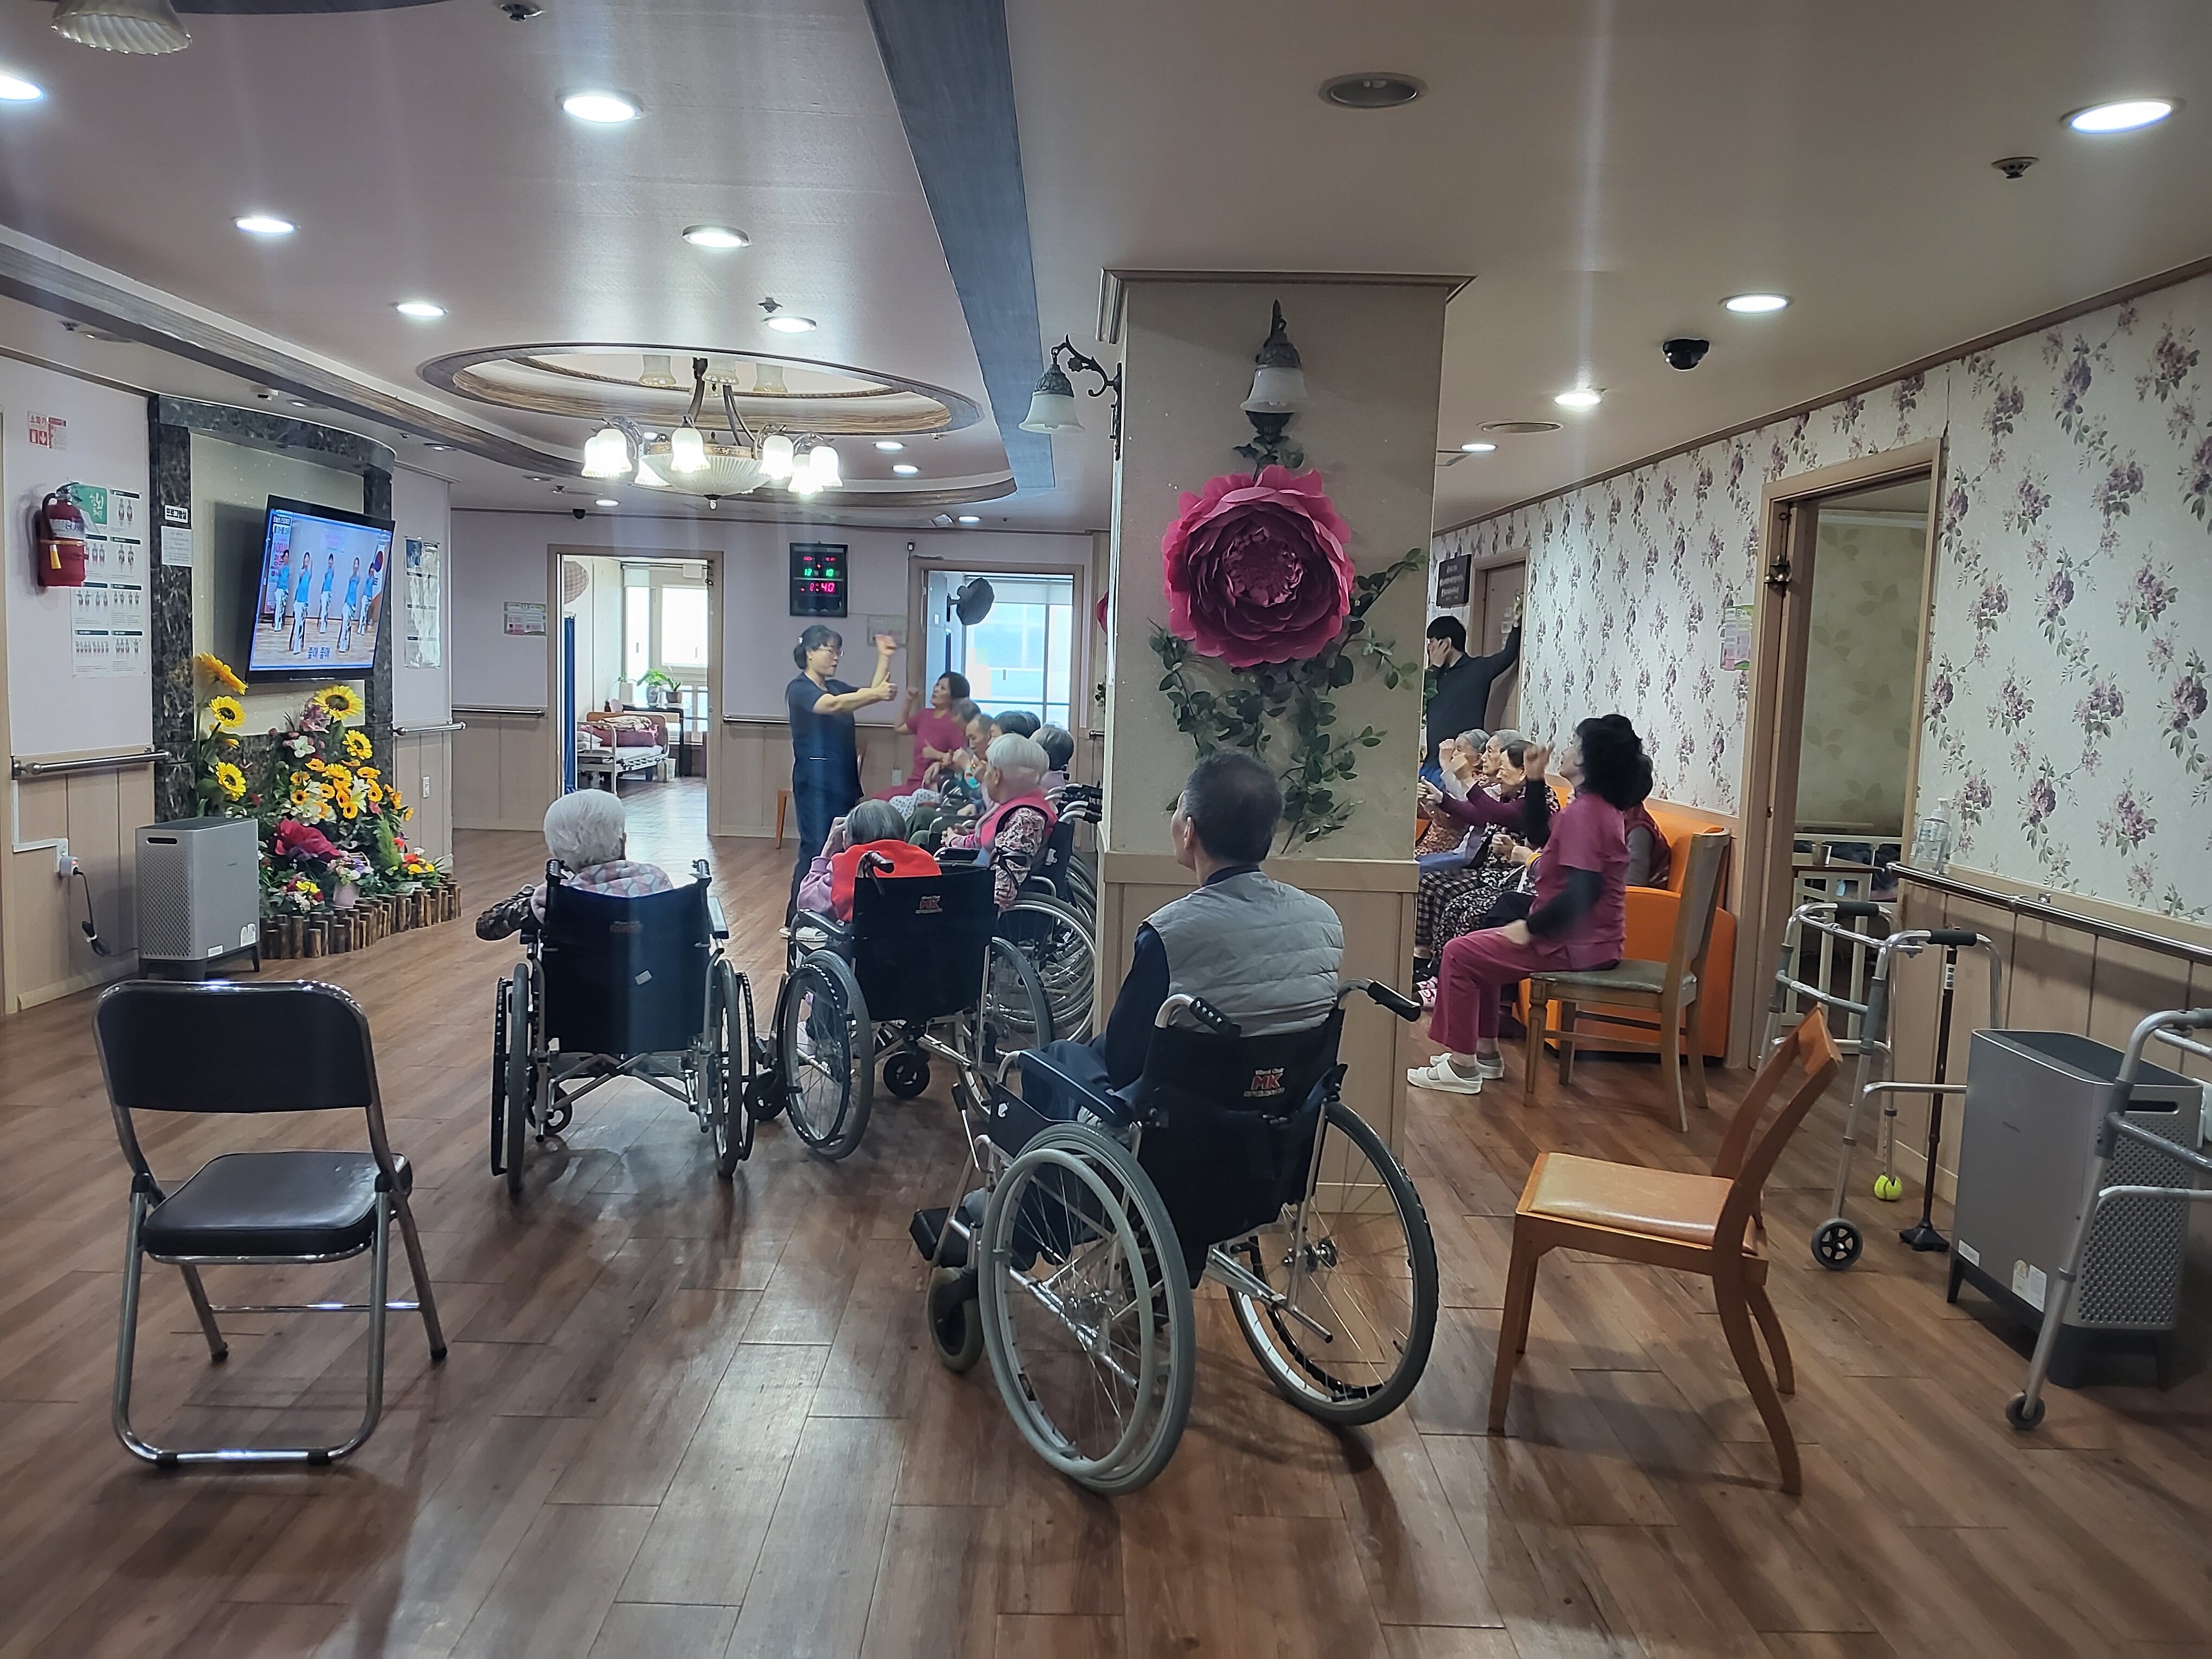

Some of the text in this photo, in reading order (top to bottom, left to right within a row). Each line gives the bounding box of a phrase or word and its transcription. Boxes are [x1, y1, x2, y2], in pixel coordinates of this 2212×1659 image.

[166, 507, 187, 520] 프로그램실
[308, 647, 330, 659] 좋아 좋아
[919, 899, 941, 909] MK
[1251, 1073, 1283, 1090] MK
